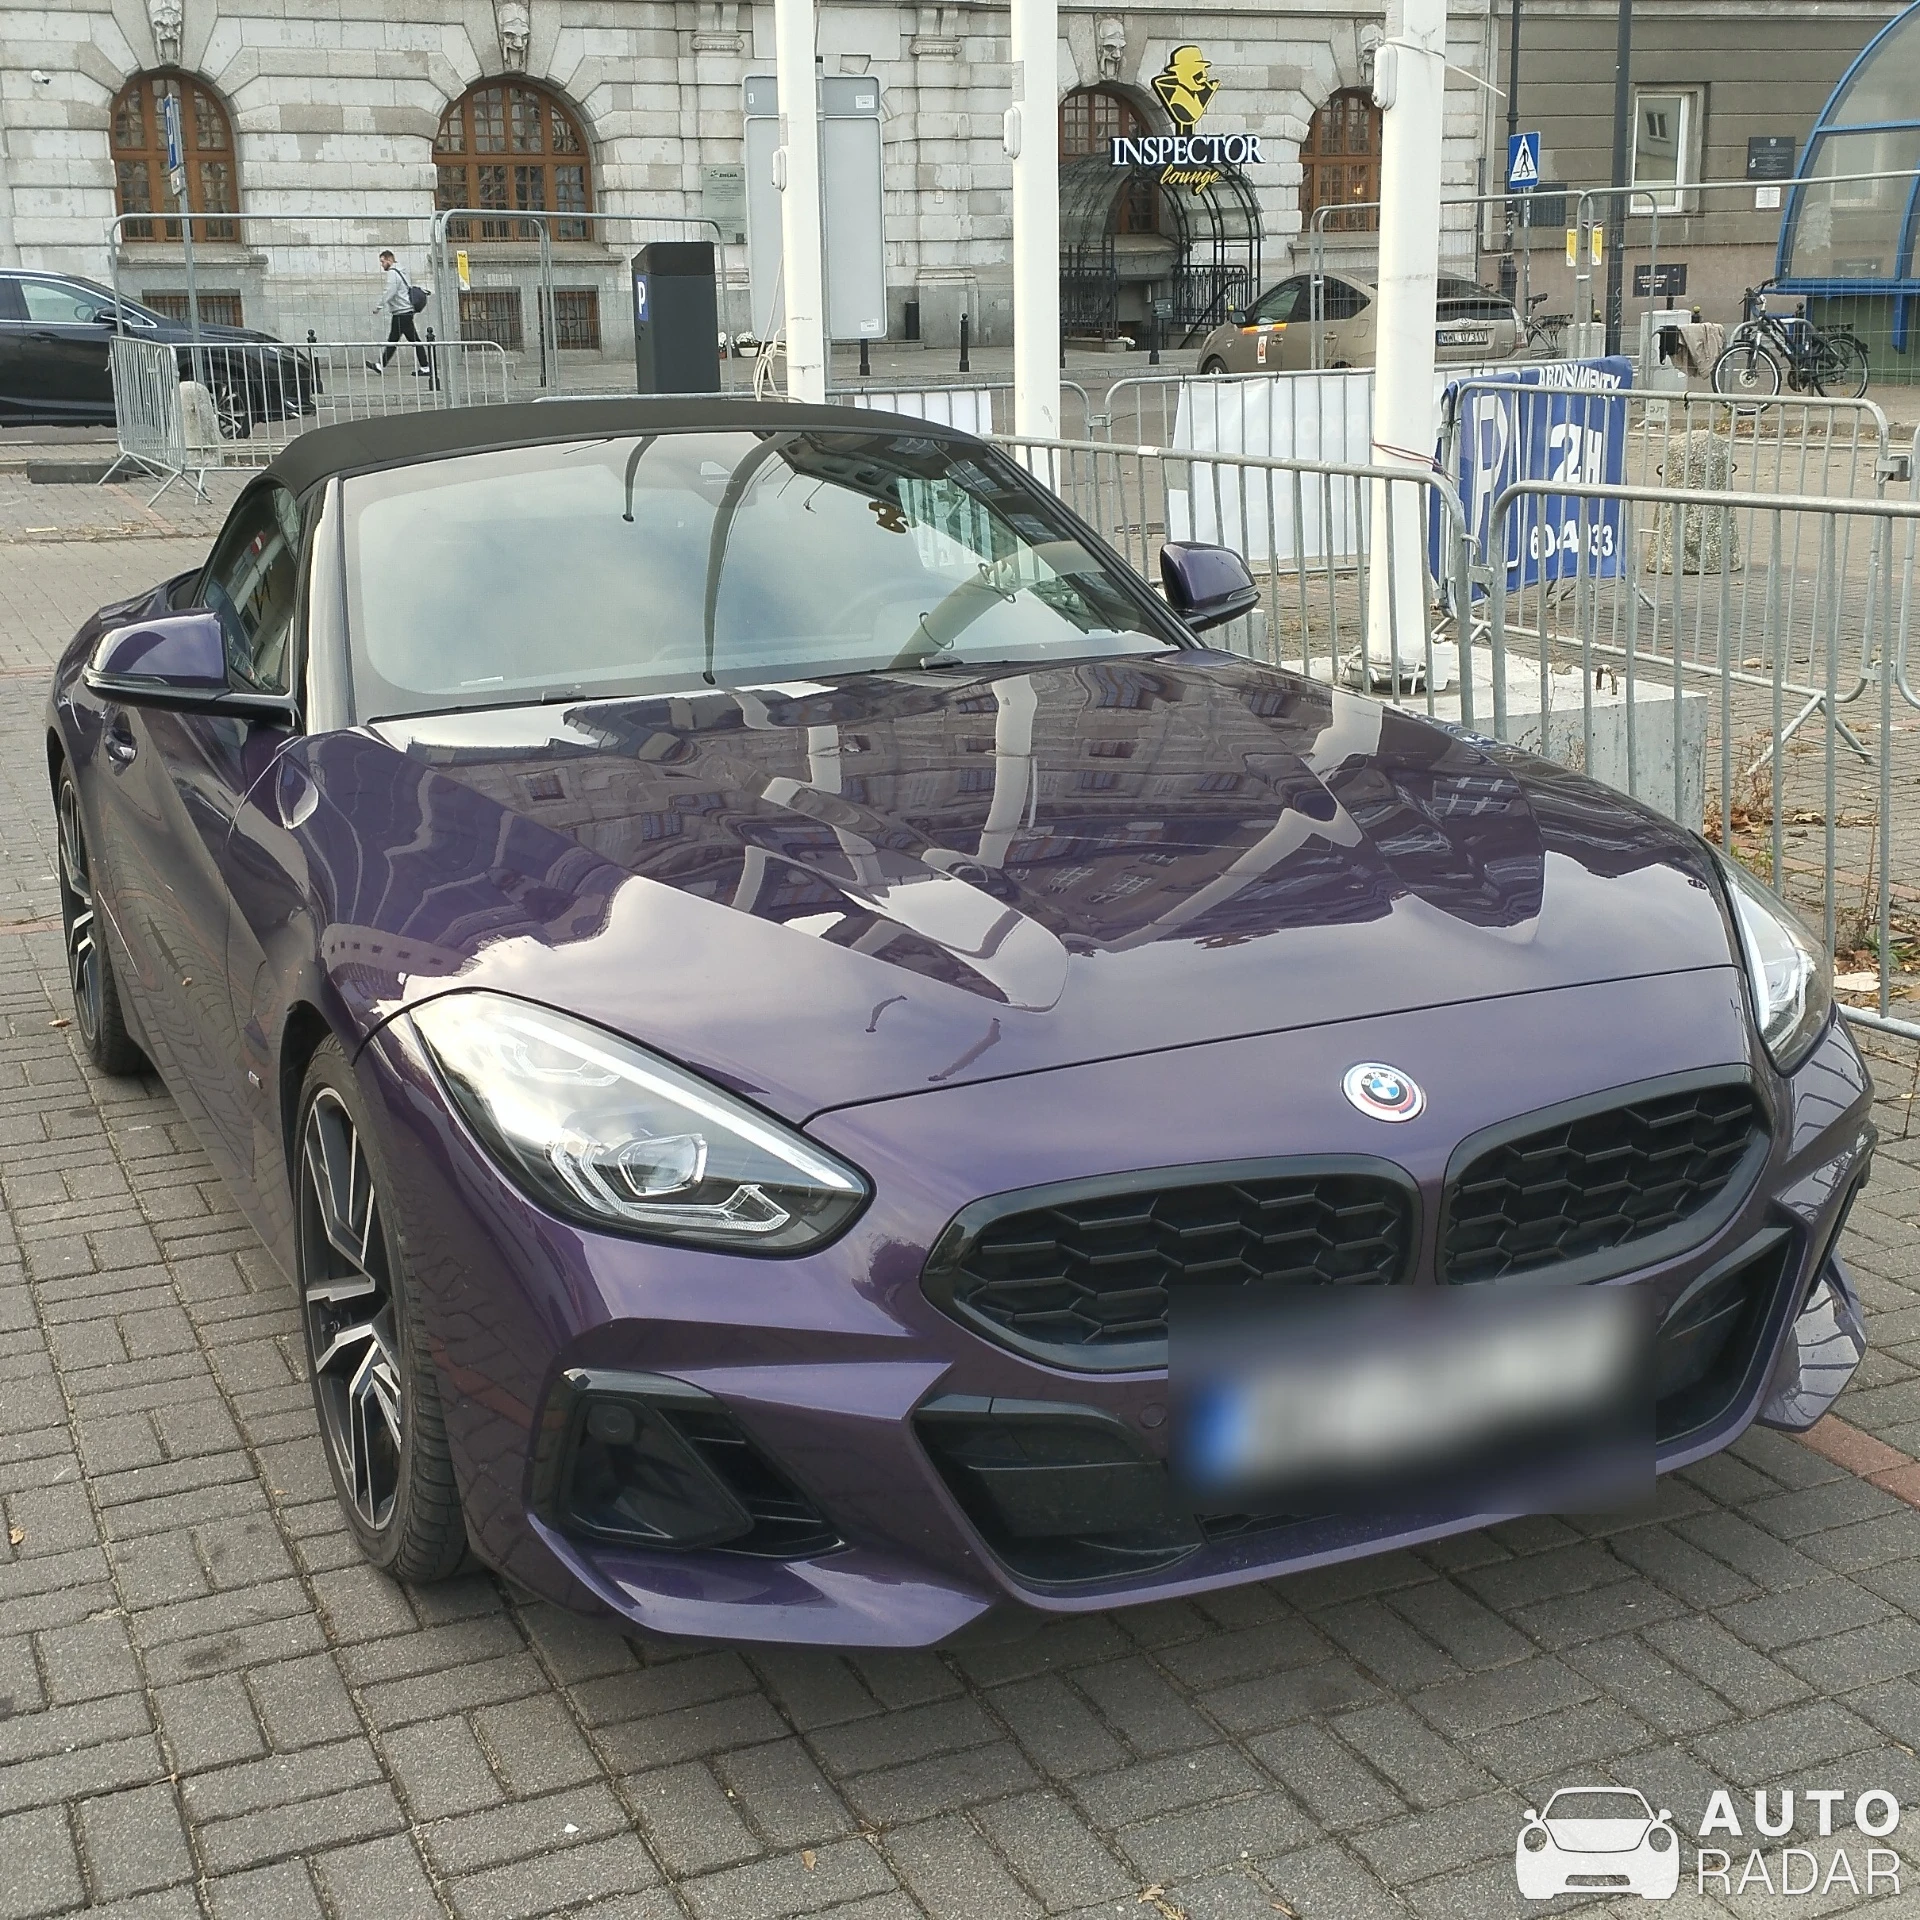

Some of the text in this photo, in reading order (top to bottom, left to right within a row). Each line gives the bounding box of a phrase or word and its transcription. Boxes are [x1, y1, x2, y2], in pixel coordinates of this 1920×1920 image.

[1112, 134, 1266, 165] INSPECTOR
[1160, 164, 1220, 194] lounge
[638, 282, 645, 314] P
[1472, 395, 1508, 539] P
[1361, 1071, 1397, 1086] BMW
